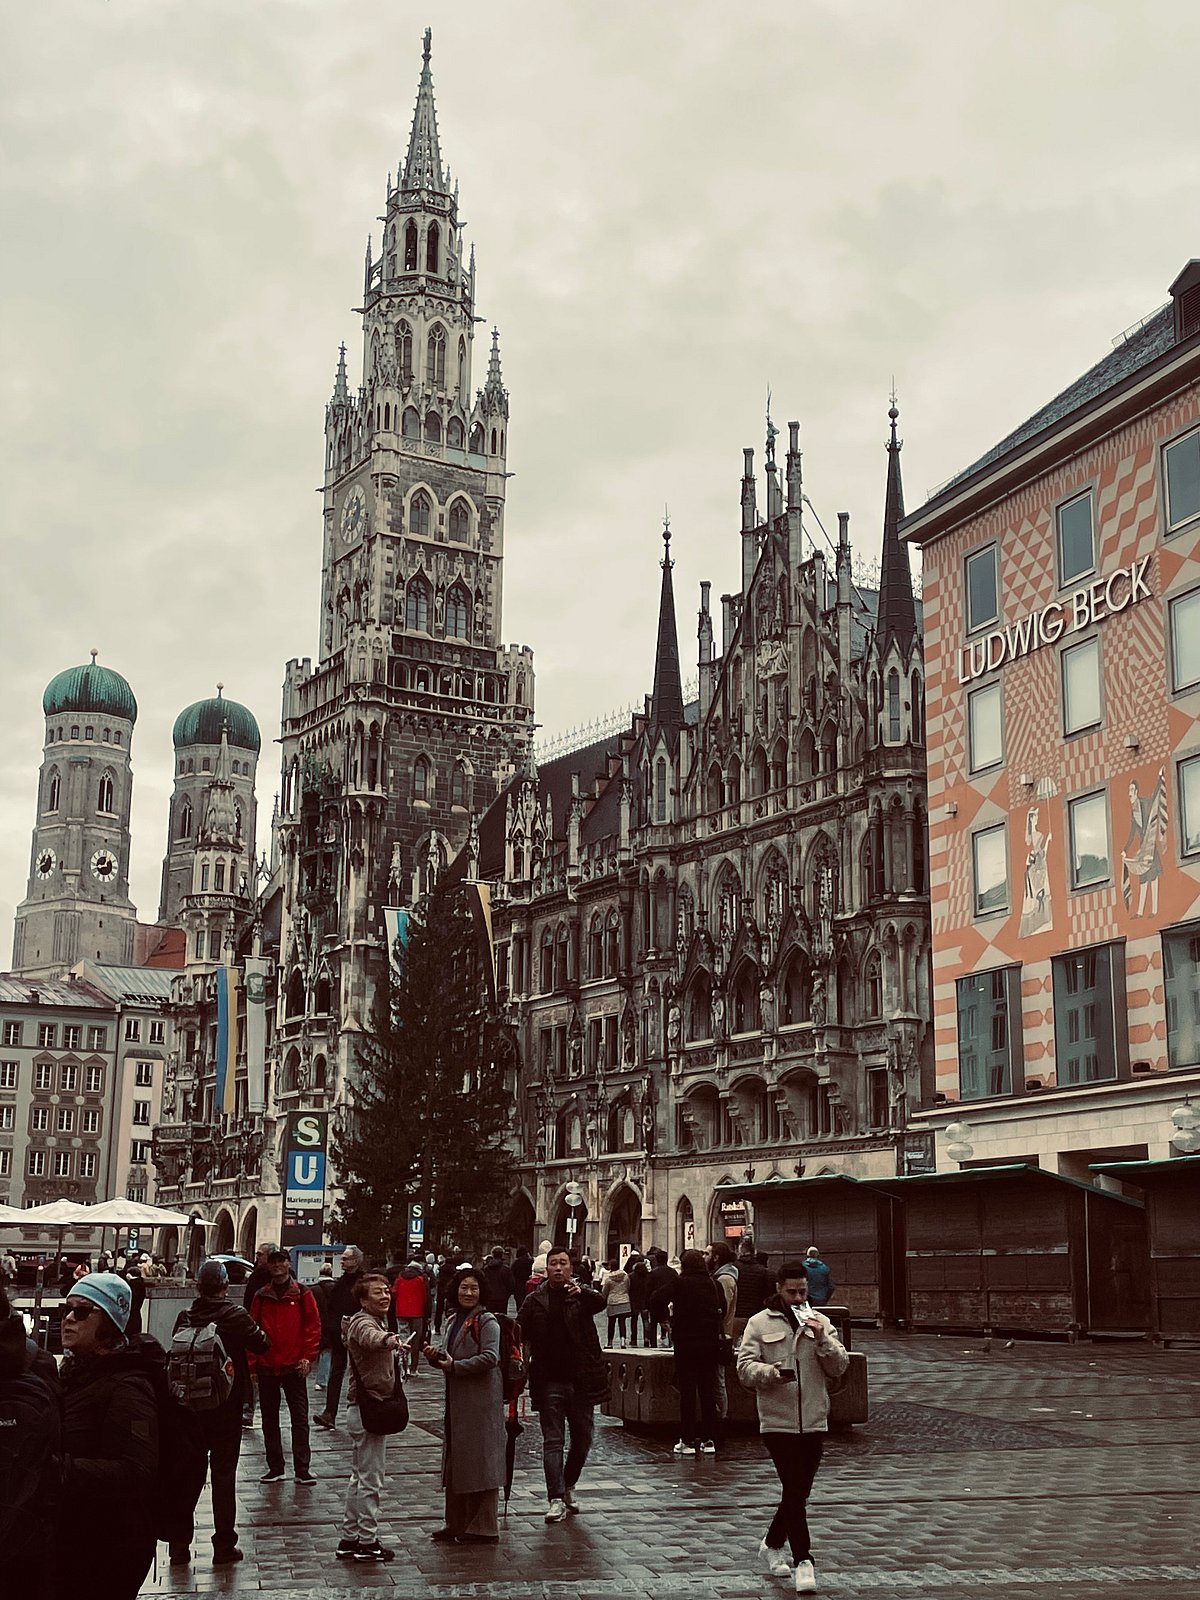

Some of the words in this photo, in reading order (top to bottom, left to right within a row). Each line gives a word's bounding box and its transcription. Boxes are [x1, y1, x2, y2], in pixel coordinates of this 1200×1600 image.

[958, 602, 1064, 684] LUDWIG
[1073, 555, 1151, 630] BECK
[297, 1116, 321, 1146] S
[294, 1155, 318, 1185] U
[412, 1204, 422, 1218] S
[130, 1228, 138, 1239] S
[412, 1220, 421, 1233] U
[129, 1239, 138, 1249] U
